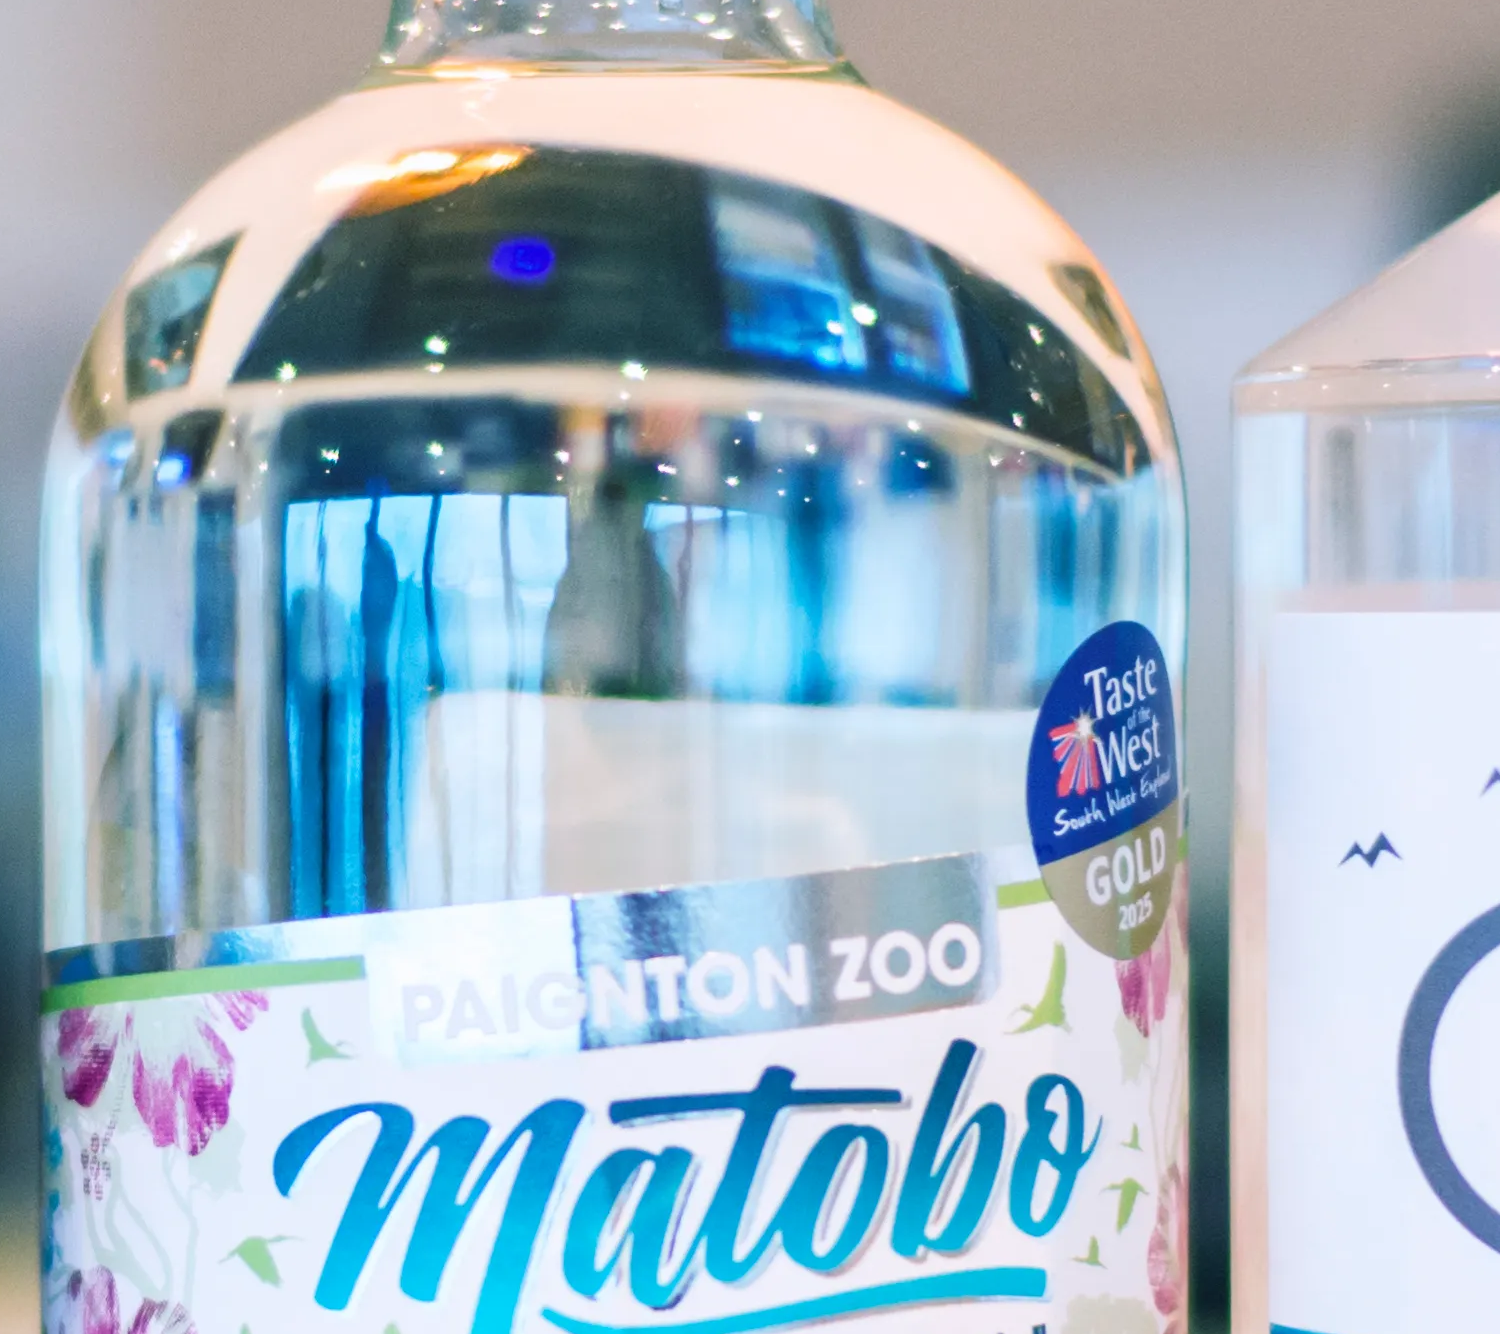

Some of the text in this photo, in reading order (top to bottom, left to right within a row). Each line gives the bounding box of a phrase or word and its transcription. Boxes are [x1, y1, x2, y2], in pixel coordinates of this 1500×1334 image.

[1084, 655, 1158, 720] Taste
[1127, 709, 1137, 731] of
[1092, 714, 1161, 785] West
[1053, 797, 1106, 836] South
[1106, 787, 1137, 817] West
[1086, 826, 1165, 906] GOLD
[401, 922, 981, 1043] PAIGNTON ZOO
